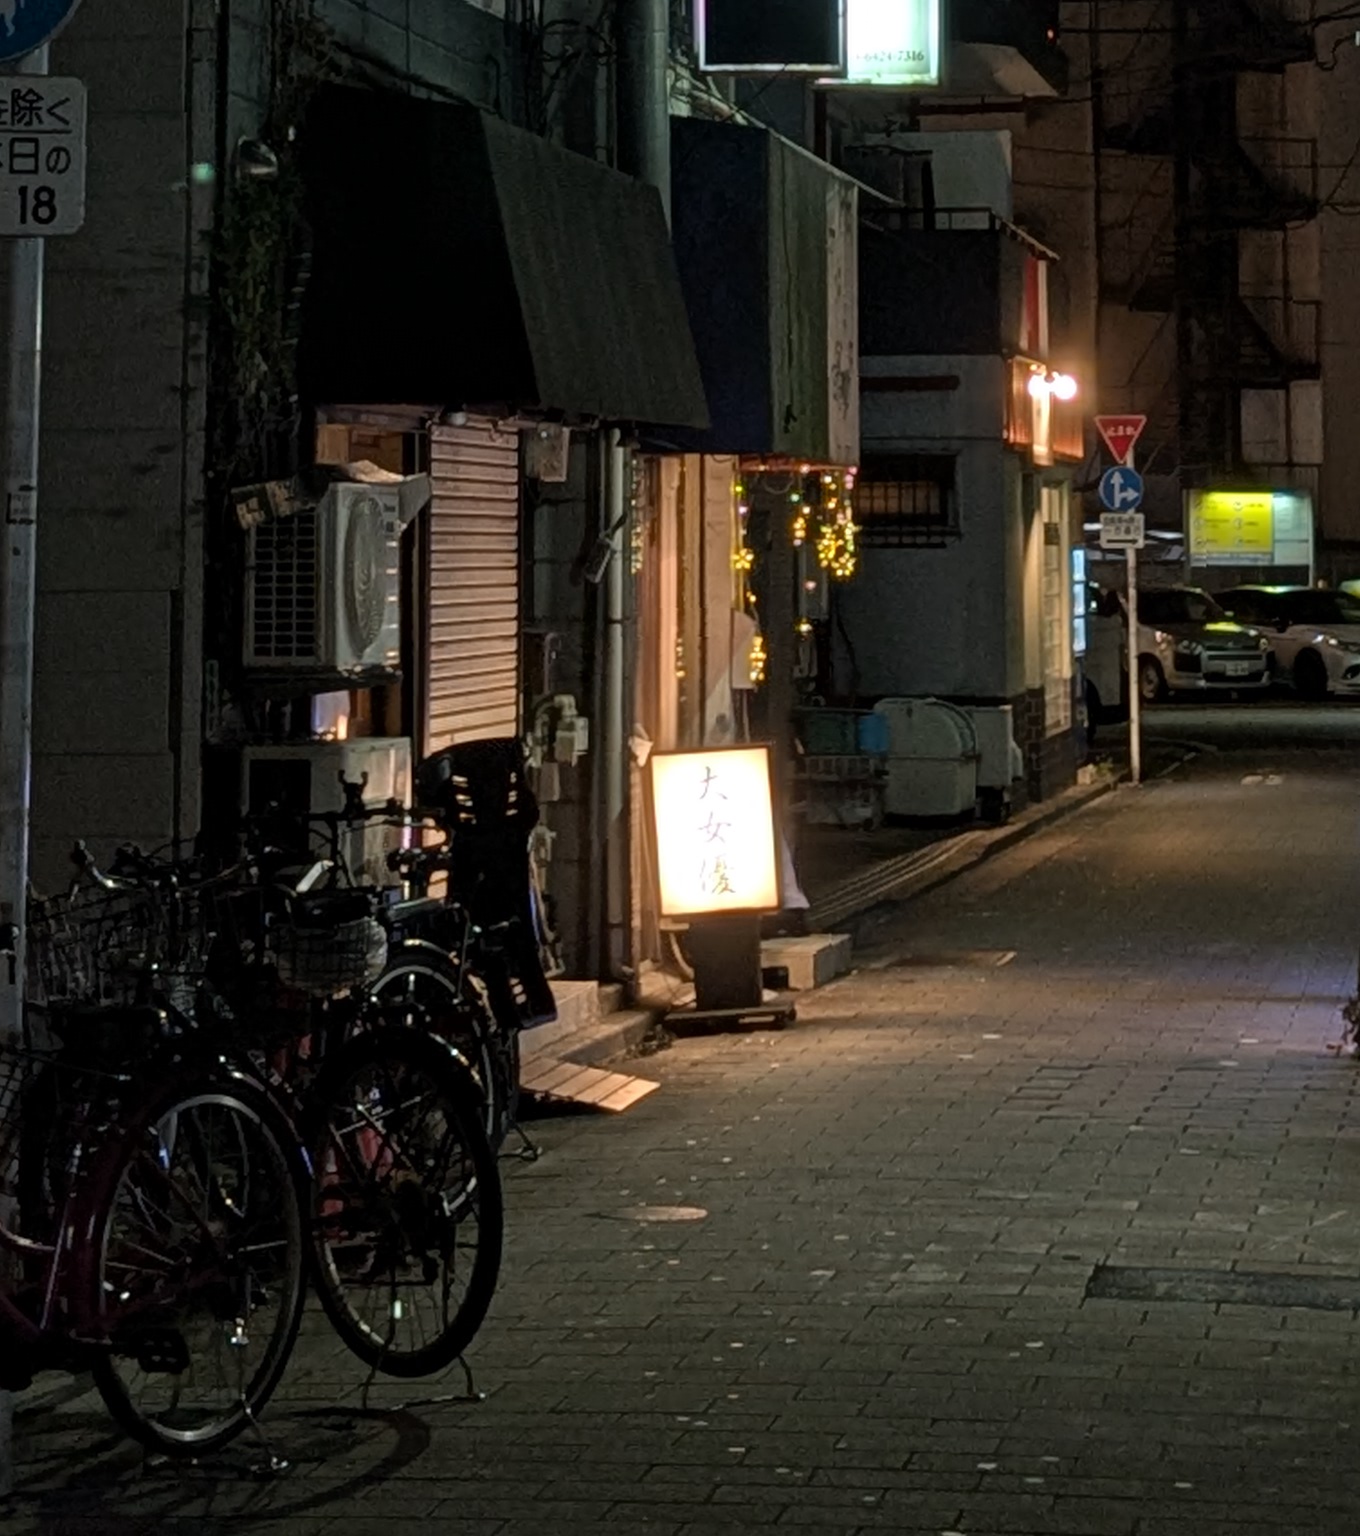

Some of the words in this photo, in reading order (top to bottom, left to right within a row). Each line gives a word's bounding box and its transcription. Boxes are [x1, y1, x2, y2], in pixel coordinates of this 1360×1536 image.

[18, 186, 57, 224] 18
[698, 765, 737, 895] 大女優
